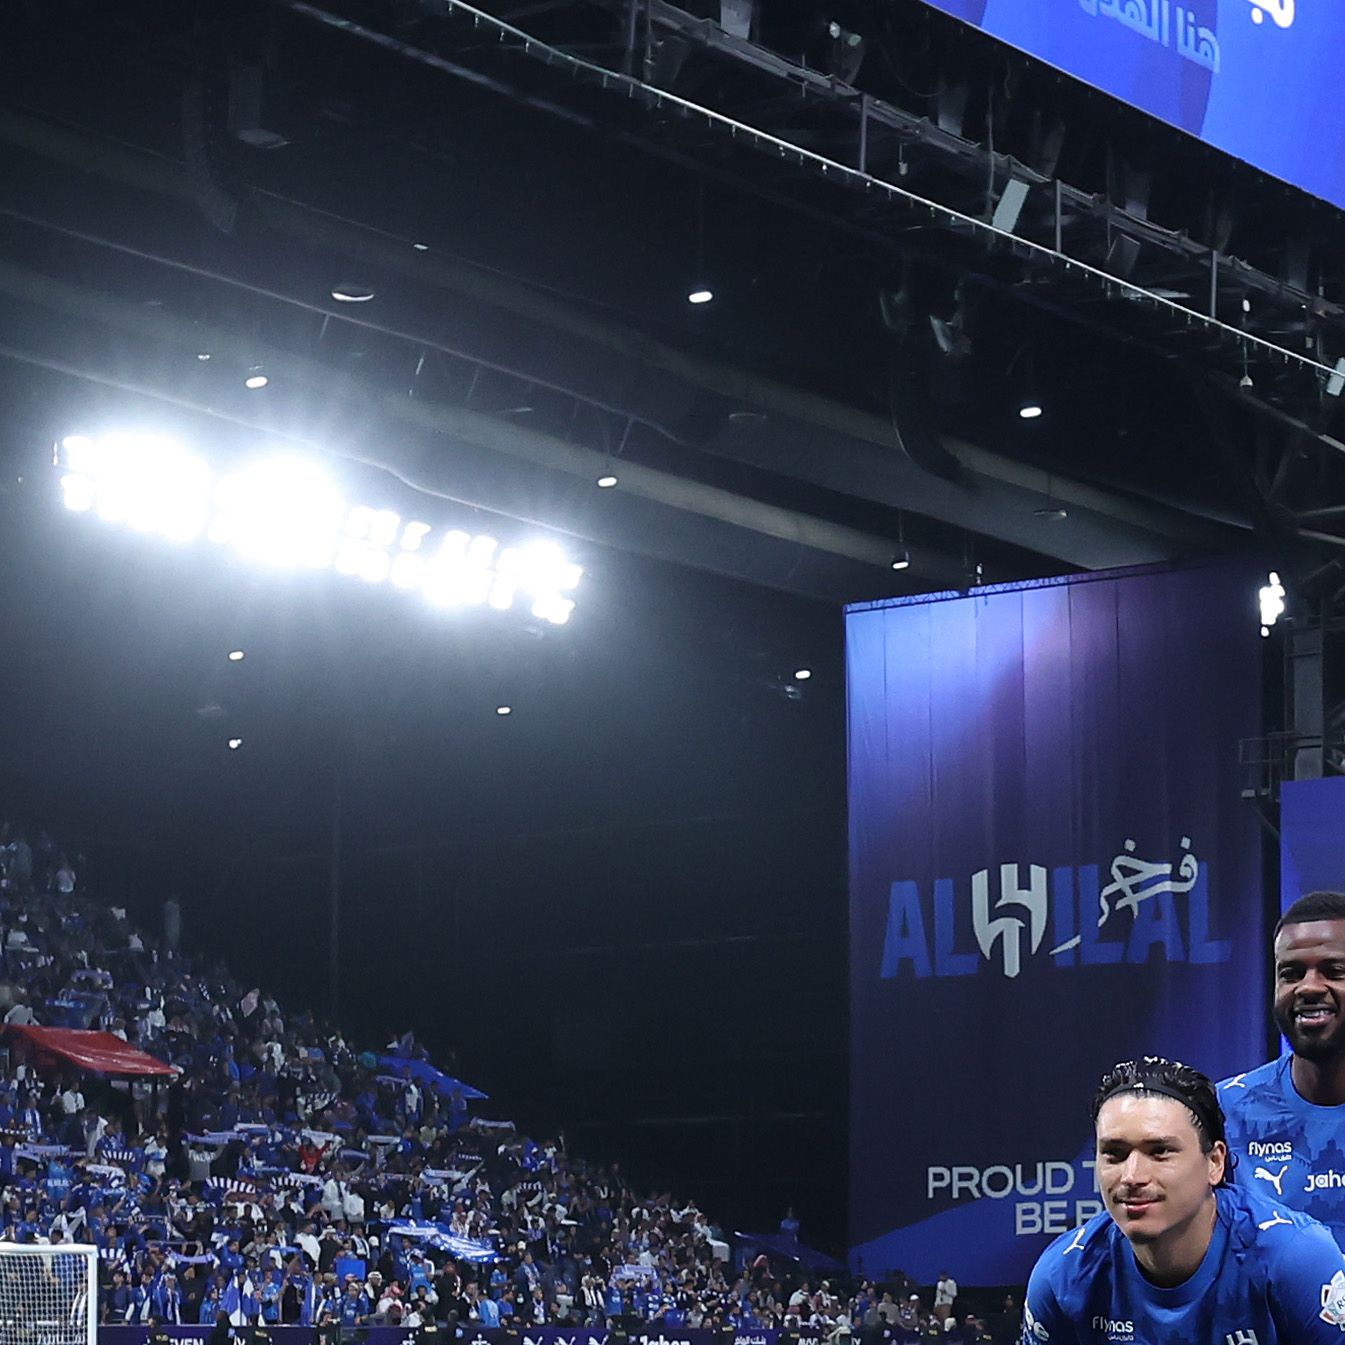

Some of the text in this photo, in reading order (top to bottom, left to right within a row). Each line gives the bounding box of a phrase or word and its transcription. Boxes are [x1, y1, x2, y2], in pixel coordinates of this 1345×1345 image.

[1248, 1141, 1292, 1157] flynas
[927, 1161, 1075, 1199] PROUD
[1015, 1201, 1068, 1235] BE
